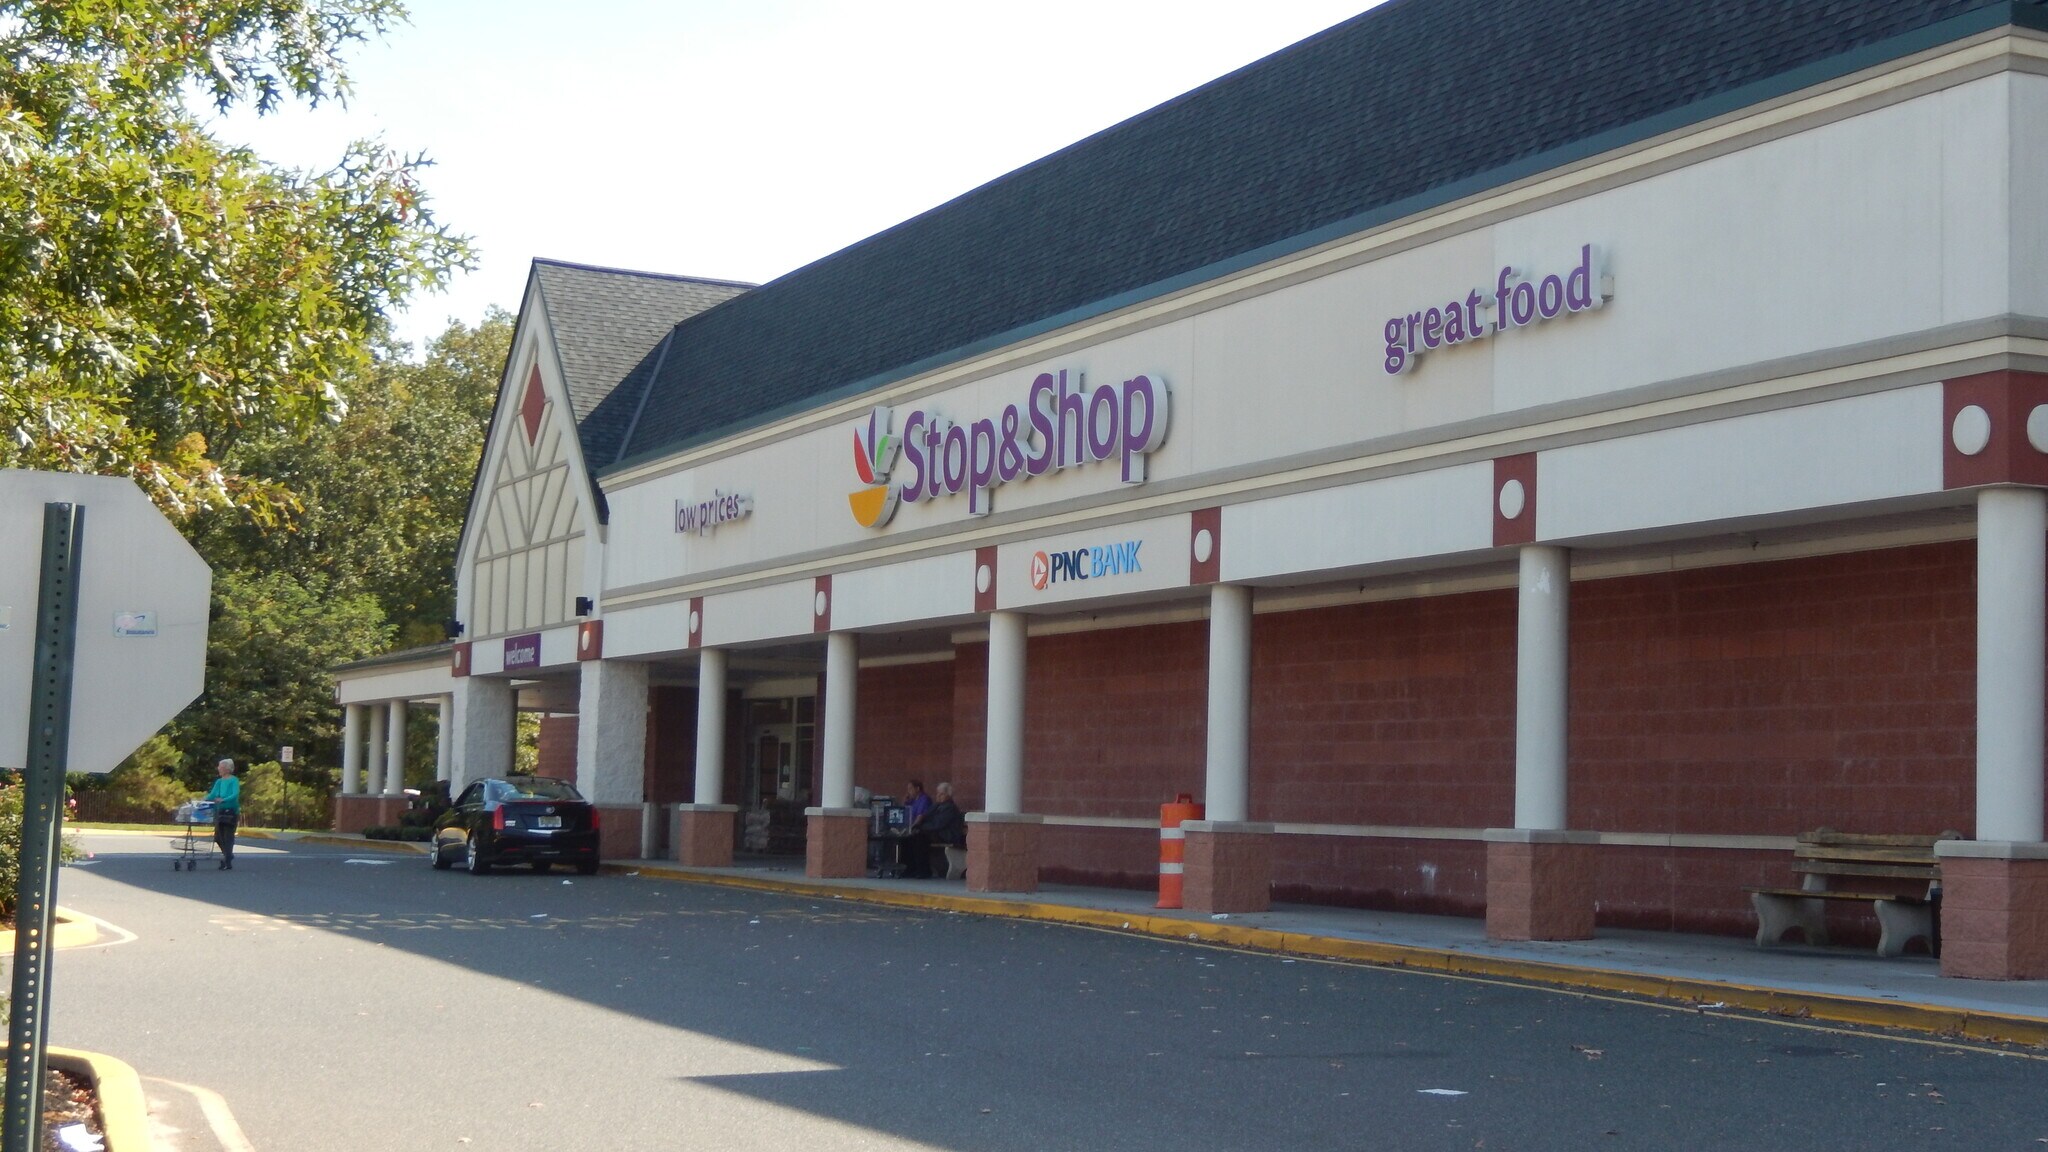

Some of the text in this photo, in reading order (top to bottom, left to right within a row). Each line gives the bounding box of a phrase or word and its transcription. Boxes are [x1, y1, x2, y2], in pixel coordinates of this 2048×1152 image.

[1384, 242, 1593, 375] great food
[902, 368, 1155, 514] Stop&Shop
[675, 488, 739, 537] low prices
[1049, 539, 1143, 583] PNC BANK
[505, 642, 535, 665] welcome
